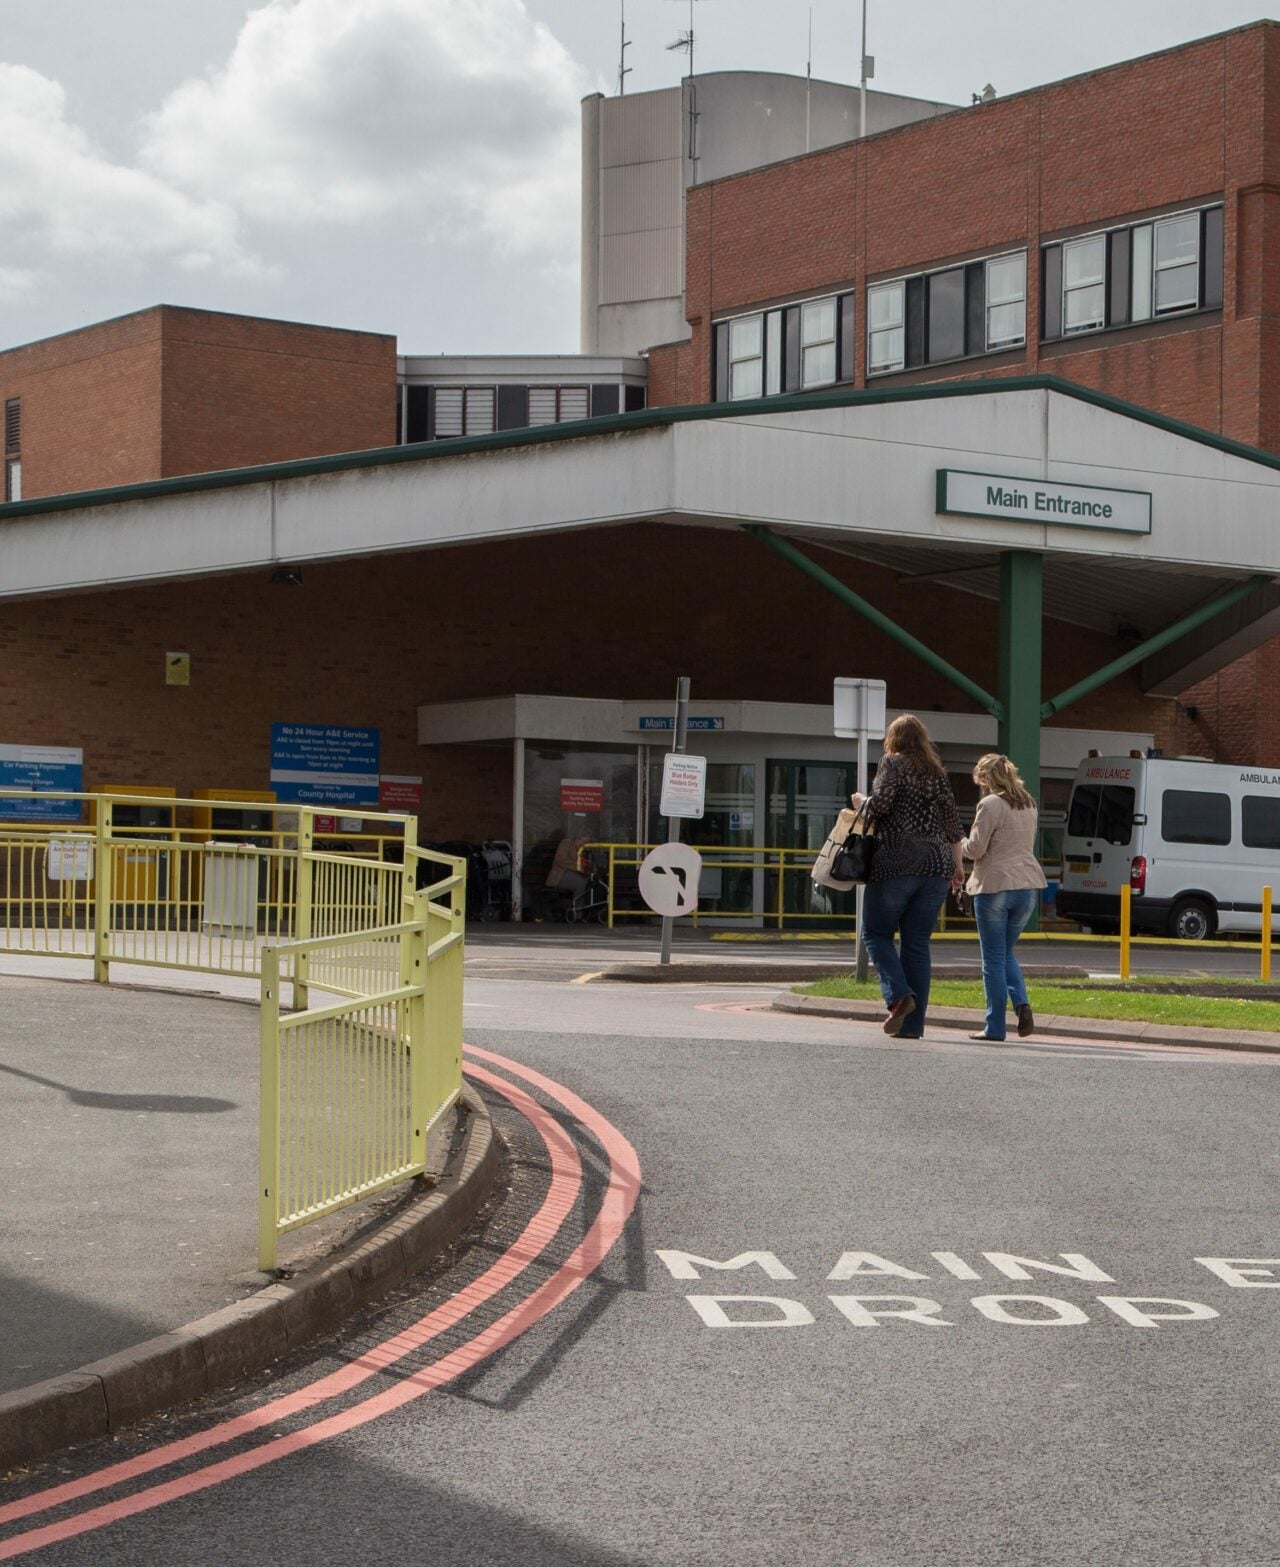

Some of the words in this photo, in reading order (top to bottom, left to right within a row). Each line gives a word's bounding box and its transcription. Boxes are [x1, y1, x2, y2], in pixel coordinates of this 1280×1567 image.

[986, 486, 1028, 509] Main
[1034, 491, 1113, 518] Entrance
[645, 718, 667, 728] Main
[669, 718, 709, 728] Eance
[282, 727, 293, 735] No
[294, 727, 304, 735] 24
[305, 728, 324, 736] Hour
[325, 729, 341, 737] A&E
[342, 730, 369, 739] Service
[15, 762, 38, 770] Parking
[39, 763, 66, 771] Payment
[682, 772, 698, 780] Badge
[1085, 767, 1131, 780] AMBULANCE
[34, 778, 54, 786] Charges
[687, 780, 699, 788] Only
[298, 789, 324, 799] County
[325, 790, 355, 799] Hospital
[653, 1249, 1117, 1283] MAIN
[684, 1294, 1221, 1328] DROP
